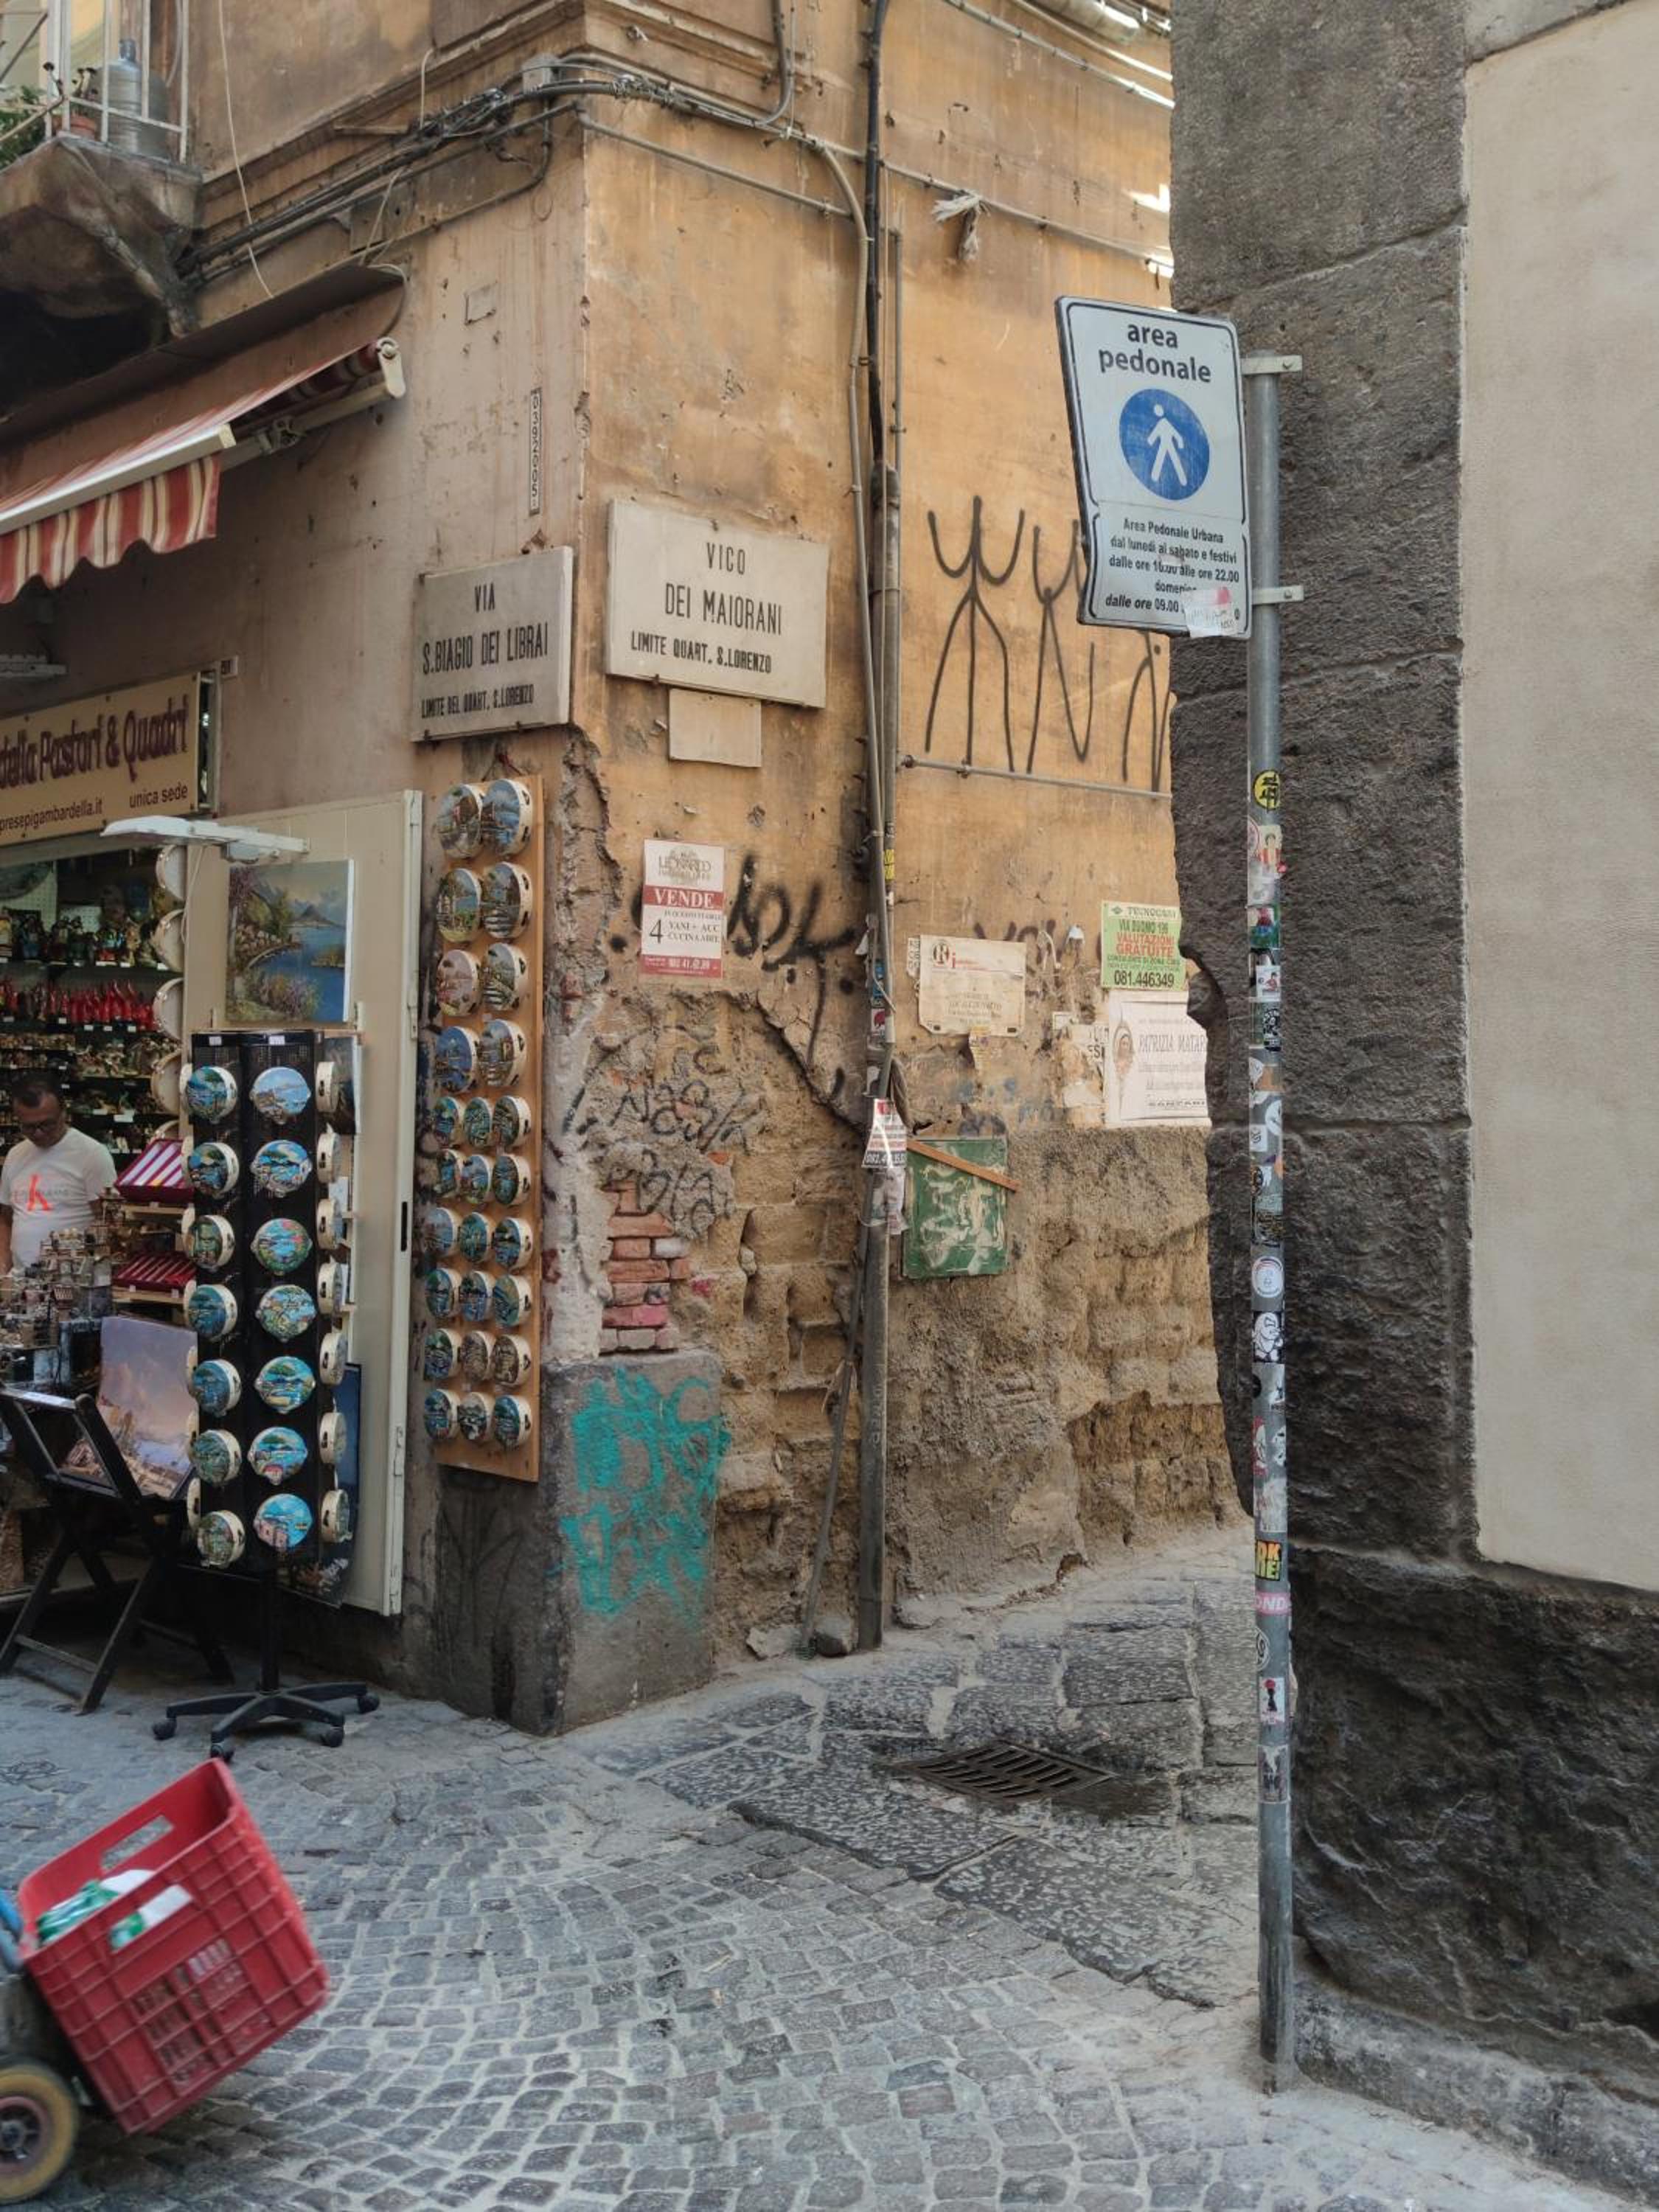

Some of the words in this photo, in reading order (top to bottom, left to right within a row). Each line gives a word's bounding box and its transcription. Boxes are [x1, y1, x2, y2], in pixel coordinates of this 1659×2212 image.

[1127, 324, 1178, 348] area
[1099, 348, 1211, 383] pedonale
[1124, 518, 1145, 532] Area
[1149, 521, 1189, 539] Pedonale
[1192, 527, 1223, 543] Urbana
[707, 542, 745, 575] VICO
[1110, 535, 1125, 548] dal
[1158, 543, 1167, 555] al
[1201, 552, 1207, 560] e
[1209, 549, 1237, 564] festivi
[1109, 554, 1133, 569] dalle
[1135, 560, 1150, 571] ore
[1180, 565, 1195, 578] alle
[1198, 568, 1212, 580] ore
[1215, 568, 1239, 582] 22.00
[474, 582, 495, 612] VIA
[665, 582, 691, 619] DEI
[703, 590, 782, 635] MAIORANI
[1105, 594, 1132, 608] dalle
[1134, 599, 1152, 610] ore
[1155, 599, 1179, 613] 09.00
[422, 635, 473, 675] S.BIAGIO
[481, 630, 500, 665] DEI
[507, 622, 548, 661] LIBRAI
[631, 630, 667, 655] LIMITE
[673, 639, 712, 664] QUART.
[717, 646, 772, 673] S.LORENZO
[421, 698, 445, 718] LIMITE
[493, 684, 535, 708] S.LORENZO
[39, 713, 103, 782] Pastori
[105, 714, 119, 768] &
[124, 694, 189, 782] Quadri
[129, 788, 159, 809] unica
[161, 784, 189, 802] sede
[653, 888, 714, 908] VENDE
[649, 919, 664, 944] 4
[1116, 932, 1175, 945] VALUTAZIONI
[1116, 943, 1175, 957] GRATUITE
[1114, 970, 1175, 988] 081.446349
